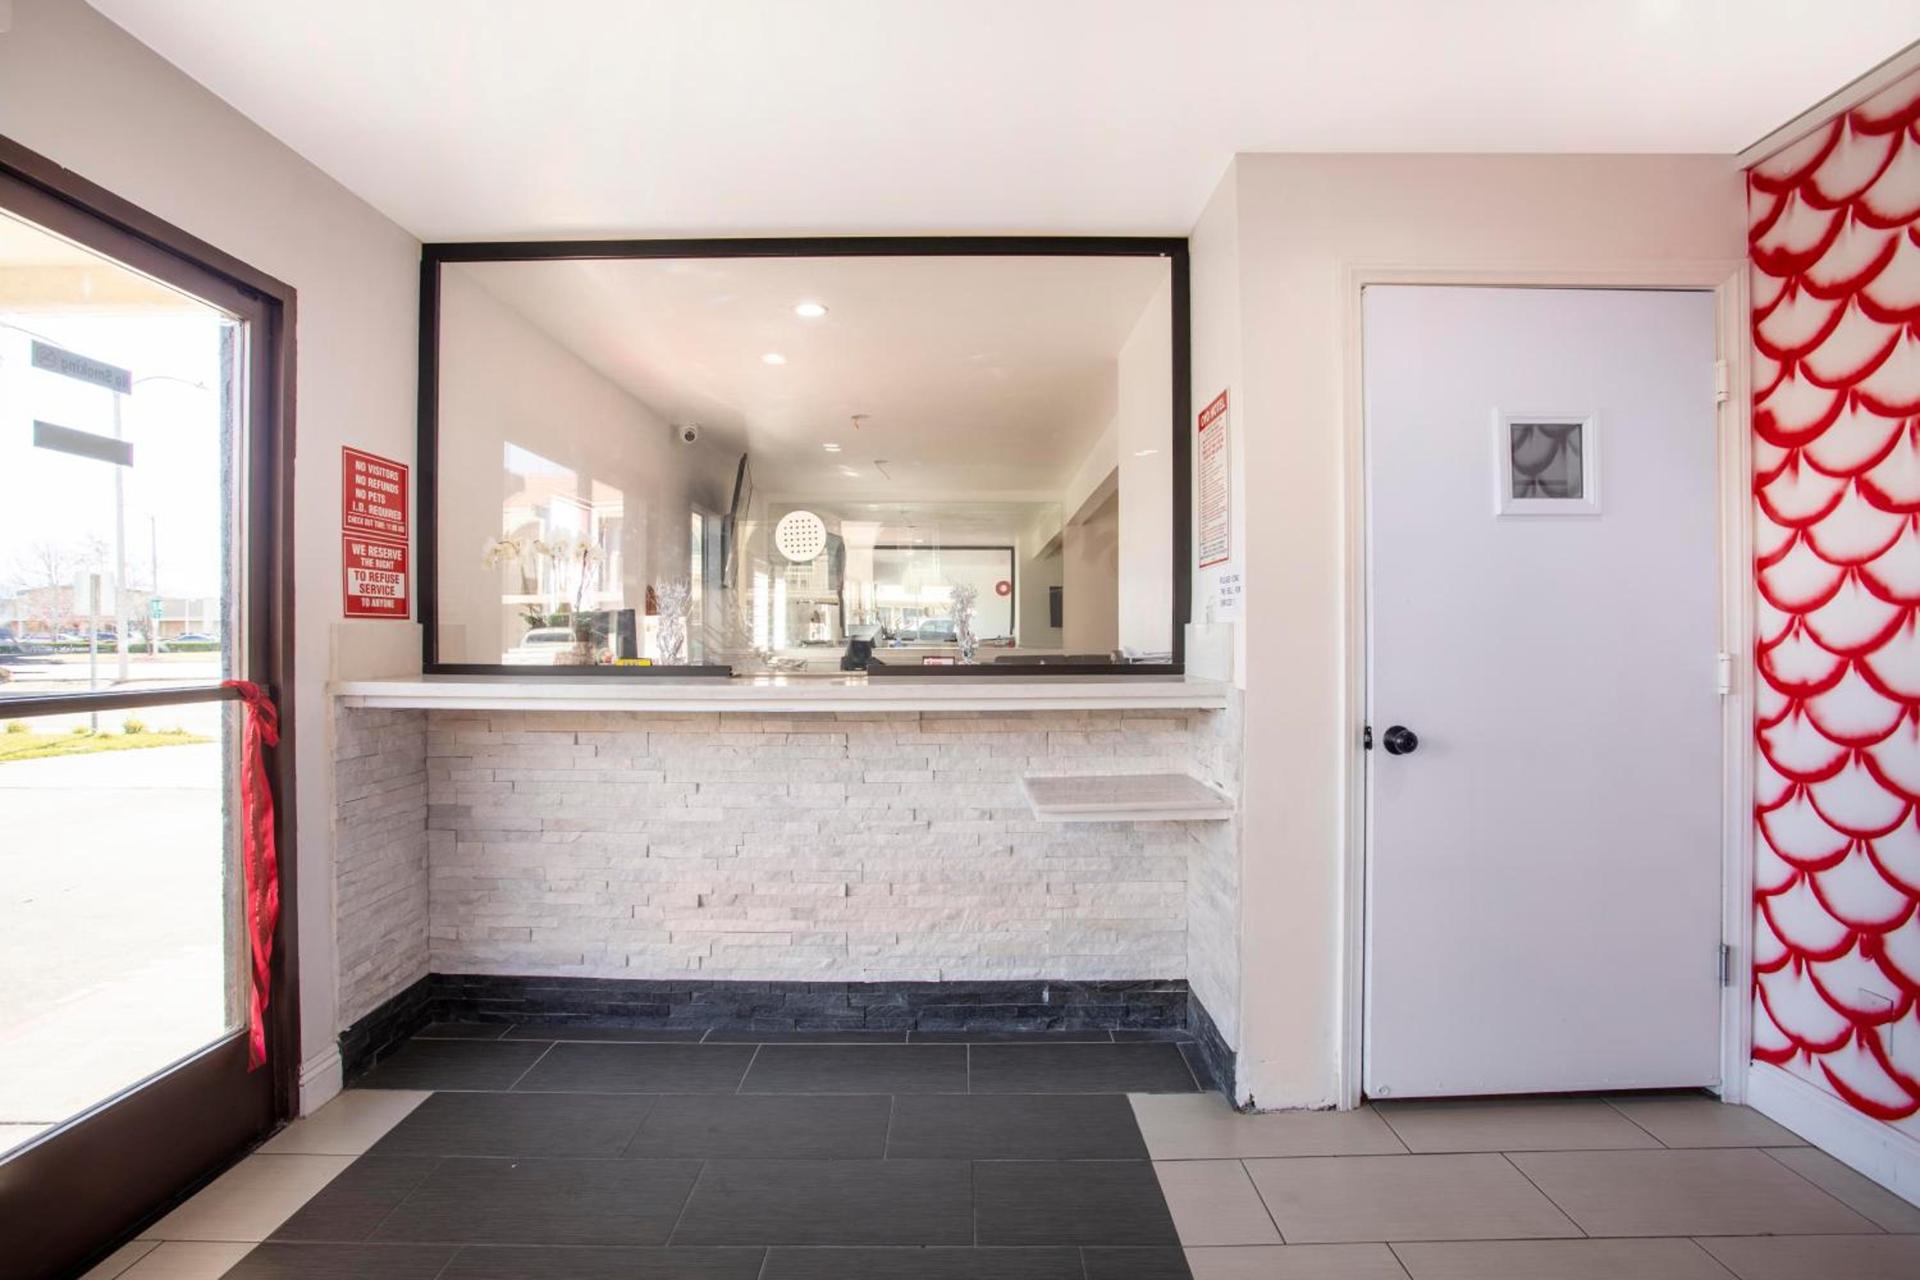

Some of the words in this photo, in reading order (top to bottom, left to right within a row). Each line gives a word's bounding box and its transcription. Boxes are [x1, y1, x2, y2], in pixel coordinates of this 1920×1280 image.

[355, 460, 366, 472] NO
[367, 463, 399, 481] VISITORS
[355, 474, 366, 486] NO
[367, 477, 399, 495] REFUNDS
[355, 488, 366, 500] NO
[367, 491, 386, 504] PETS
[352, 500, 367, 513] I.D.
[368, 504, 402, 521] REQUIRED
[347, 515, 364, 526] CHECK
[352, 543, 367, 556] WE
[368, 545, 402, 561] RESERVE
[361, 557, 376, 568] THE
[376, 559, 394, 570] RIGHT
[354, 571, 366, 582] TO
[368, 571, 400, 584] REFUSE
[360, 583, 395, 596] SERVICE
[361, 597, 371, 608] TO
[371, 599, 395, 609] ANYONE
